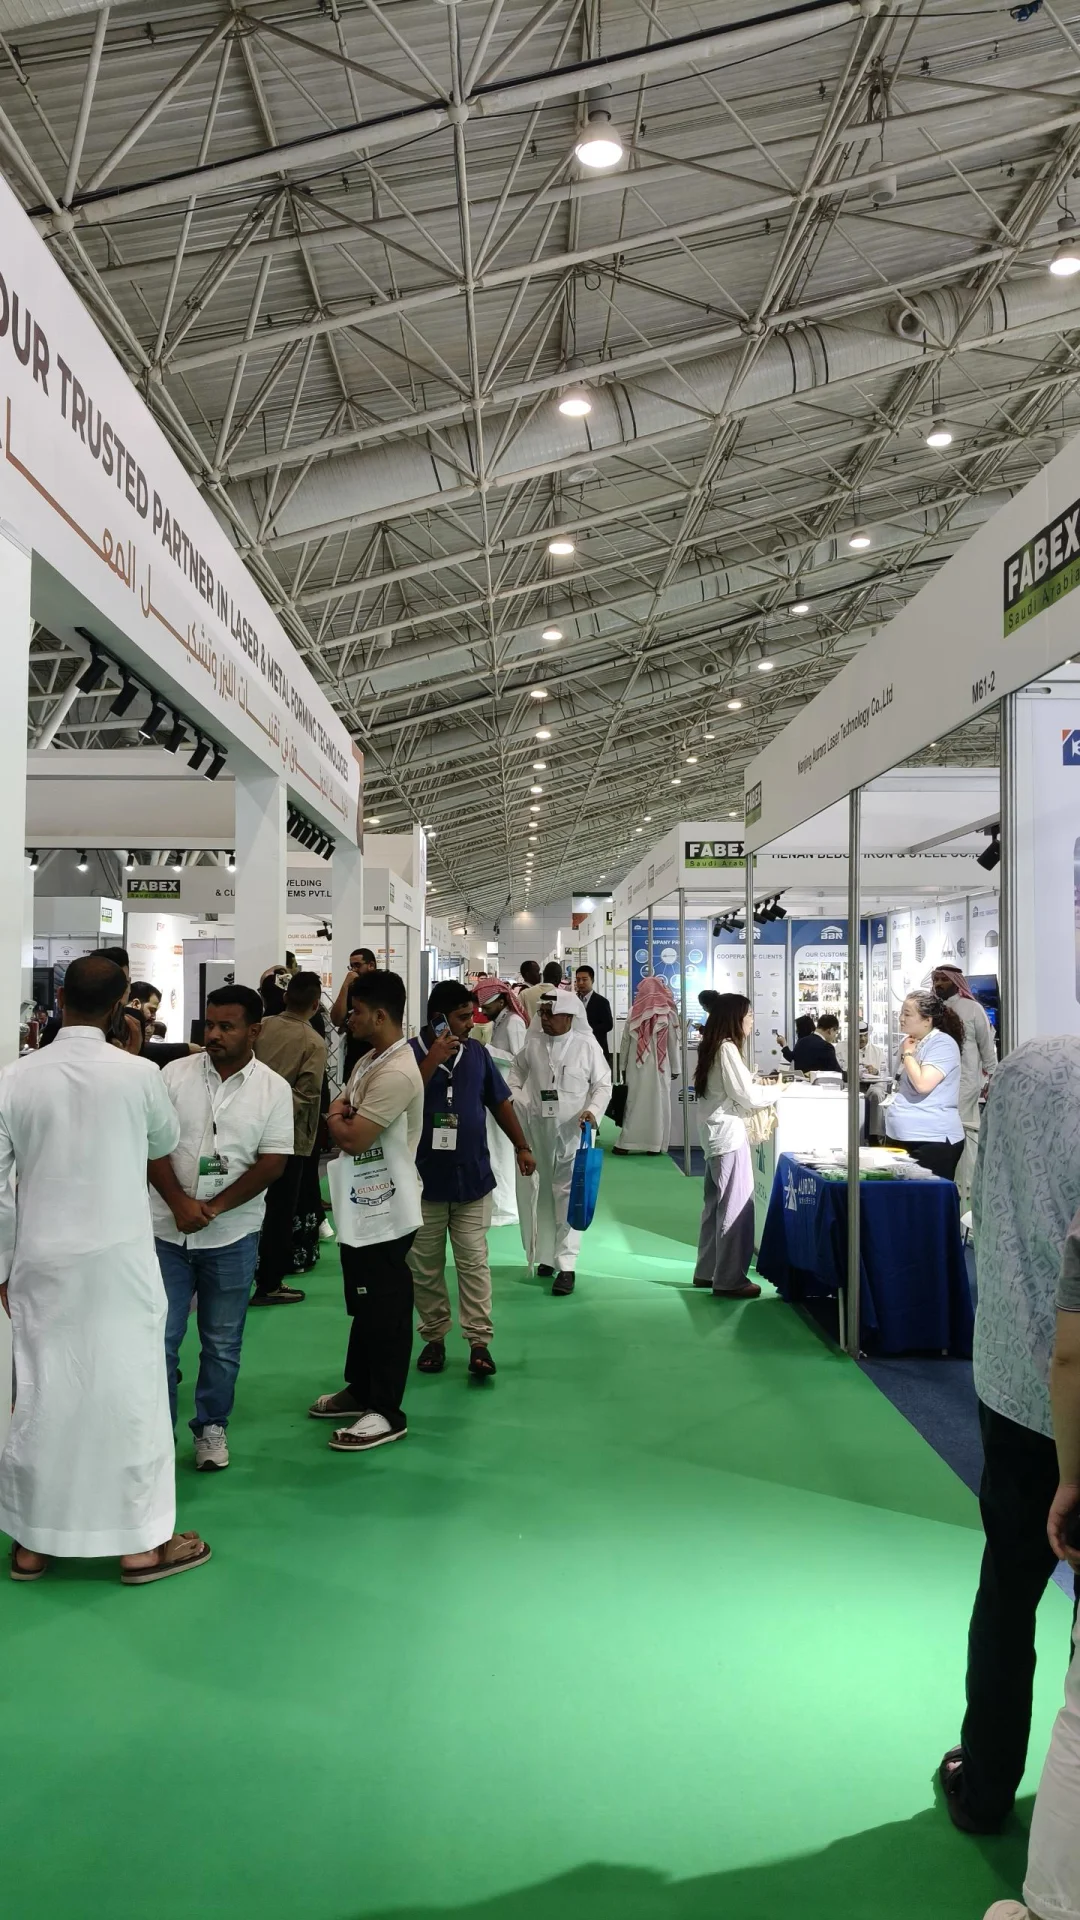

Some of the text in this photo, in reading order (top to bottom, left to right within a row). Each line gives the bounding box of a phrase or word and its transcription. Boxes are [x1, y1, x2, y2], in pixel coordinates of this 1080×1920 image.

[0, 396, 136, 593] المعا
[57, 353, 148, 519] TRUSTED
[153, 489, 214, 609] PARTNER
[217, 580, 228, 627] IN
[231, 599, 259, 668] LASER
[260, 643, 266, 676] &
[268, 652, 289, 709] METAL
[291, 686, 317, 743] FORMING
[1008, 507, 1080, 602] FABEX
[1008, 567, 1080, 629] Saudi Arabia
[141, 564, 217, 690] وتشكيل
[972, 670, 995, 704] M61-2
[827, 731, 840, 752] Laser
[841, 706, 870, 741] Technology
[871, 683, 893, 717] Co.,Ltd
[130, 881, 178, 891] FABEX
[215, 889, 235, 897] & CU
[308, 890, 332, 898] PVT.L
[738, 932, 761, 940] BN
[820, 932, 844, 940] BBN
[357, 1182, 390, 1195] GUMACO
